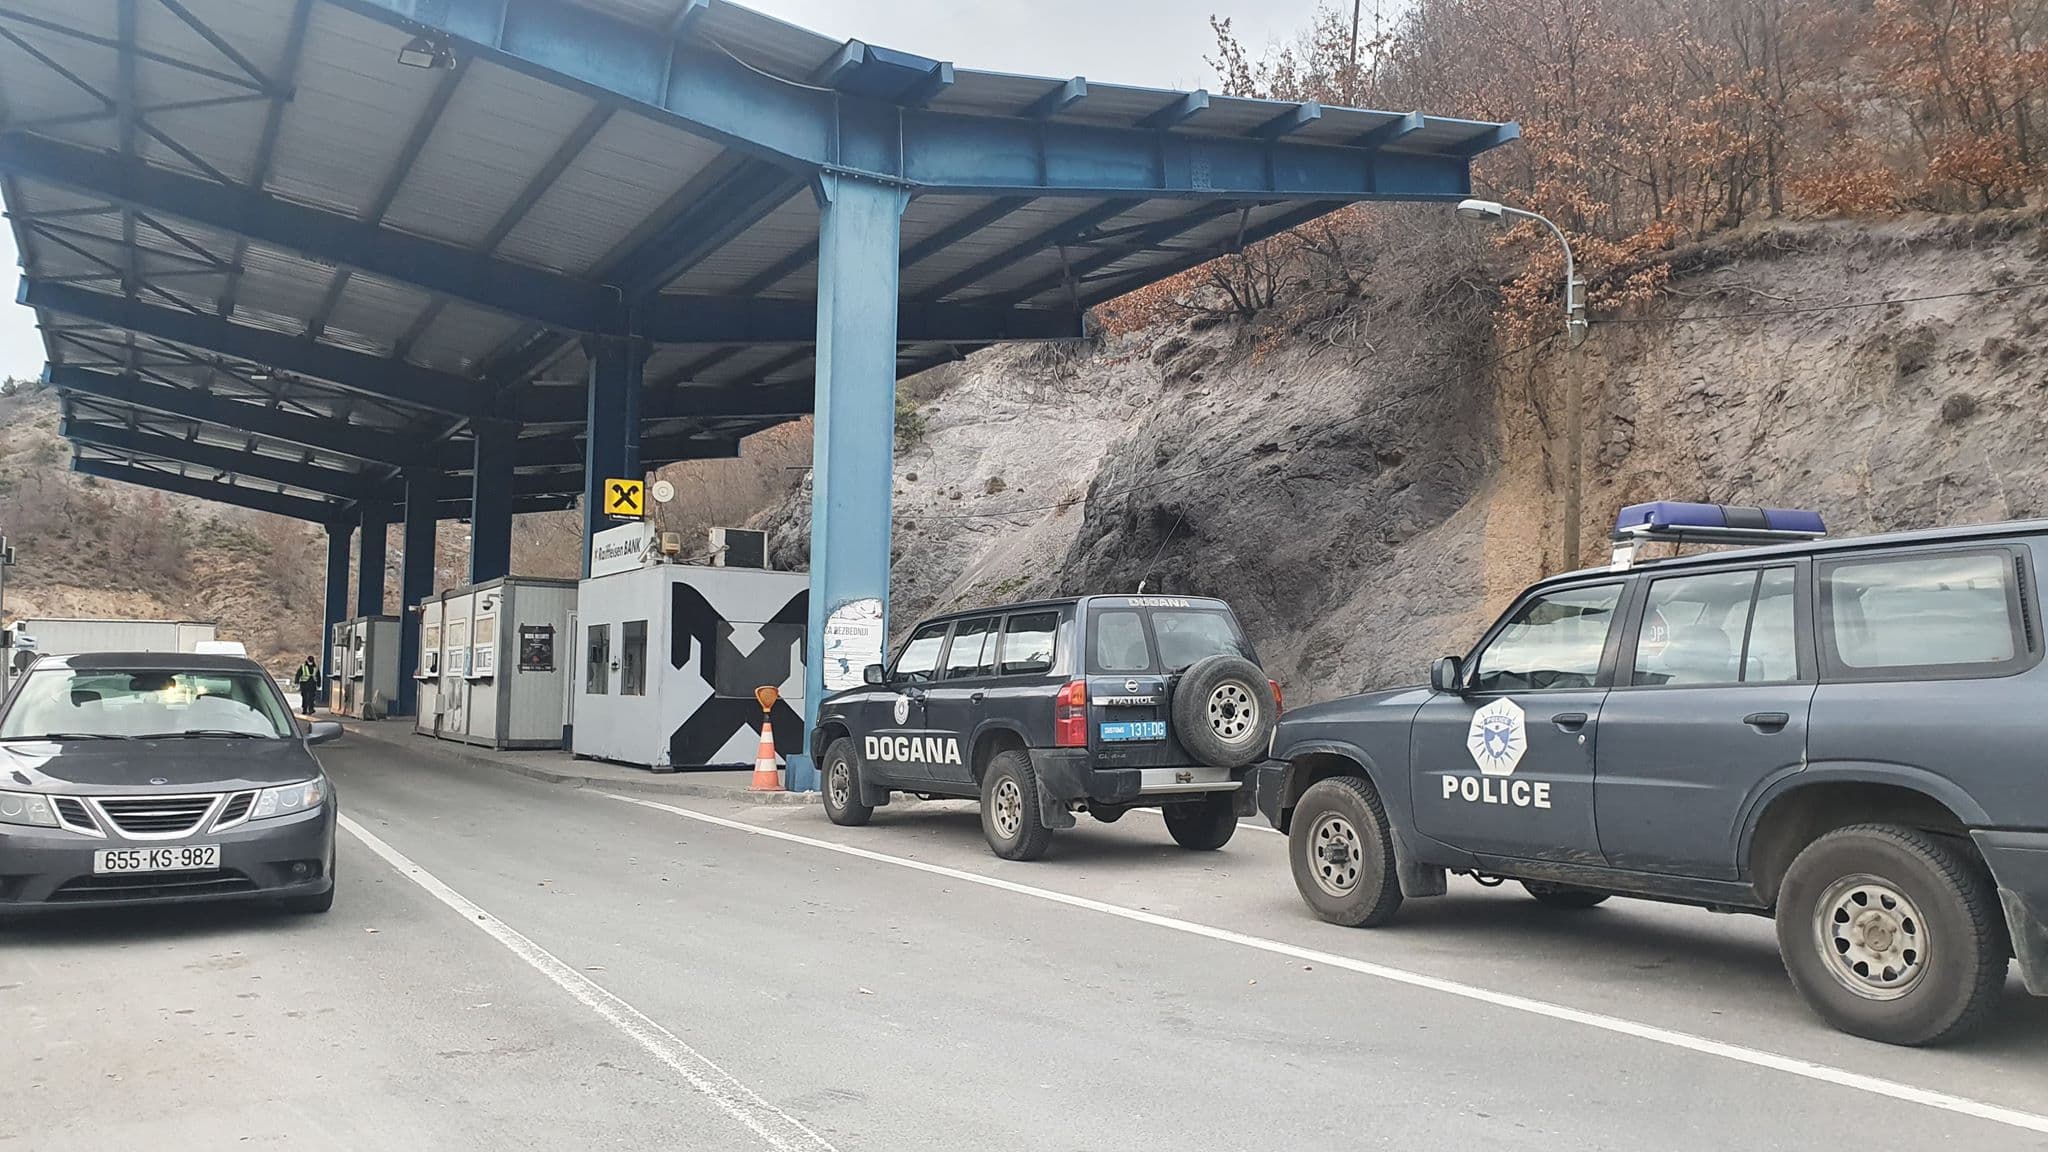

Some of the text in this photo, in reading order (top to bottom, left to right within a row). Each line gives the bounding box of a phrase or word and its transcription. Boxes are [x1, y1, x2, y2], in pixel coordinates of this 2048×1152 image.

[624, 537, 642, 555] BANK
[1128, 599, 1190, 607] DOGANA
[865, 736, 962, 765] DOGANA
[1442, 775, 1551, 809] POLICE
[105, 848, 214, 870] 655-KS-982
